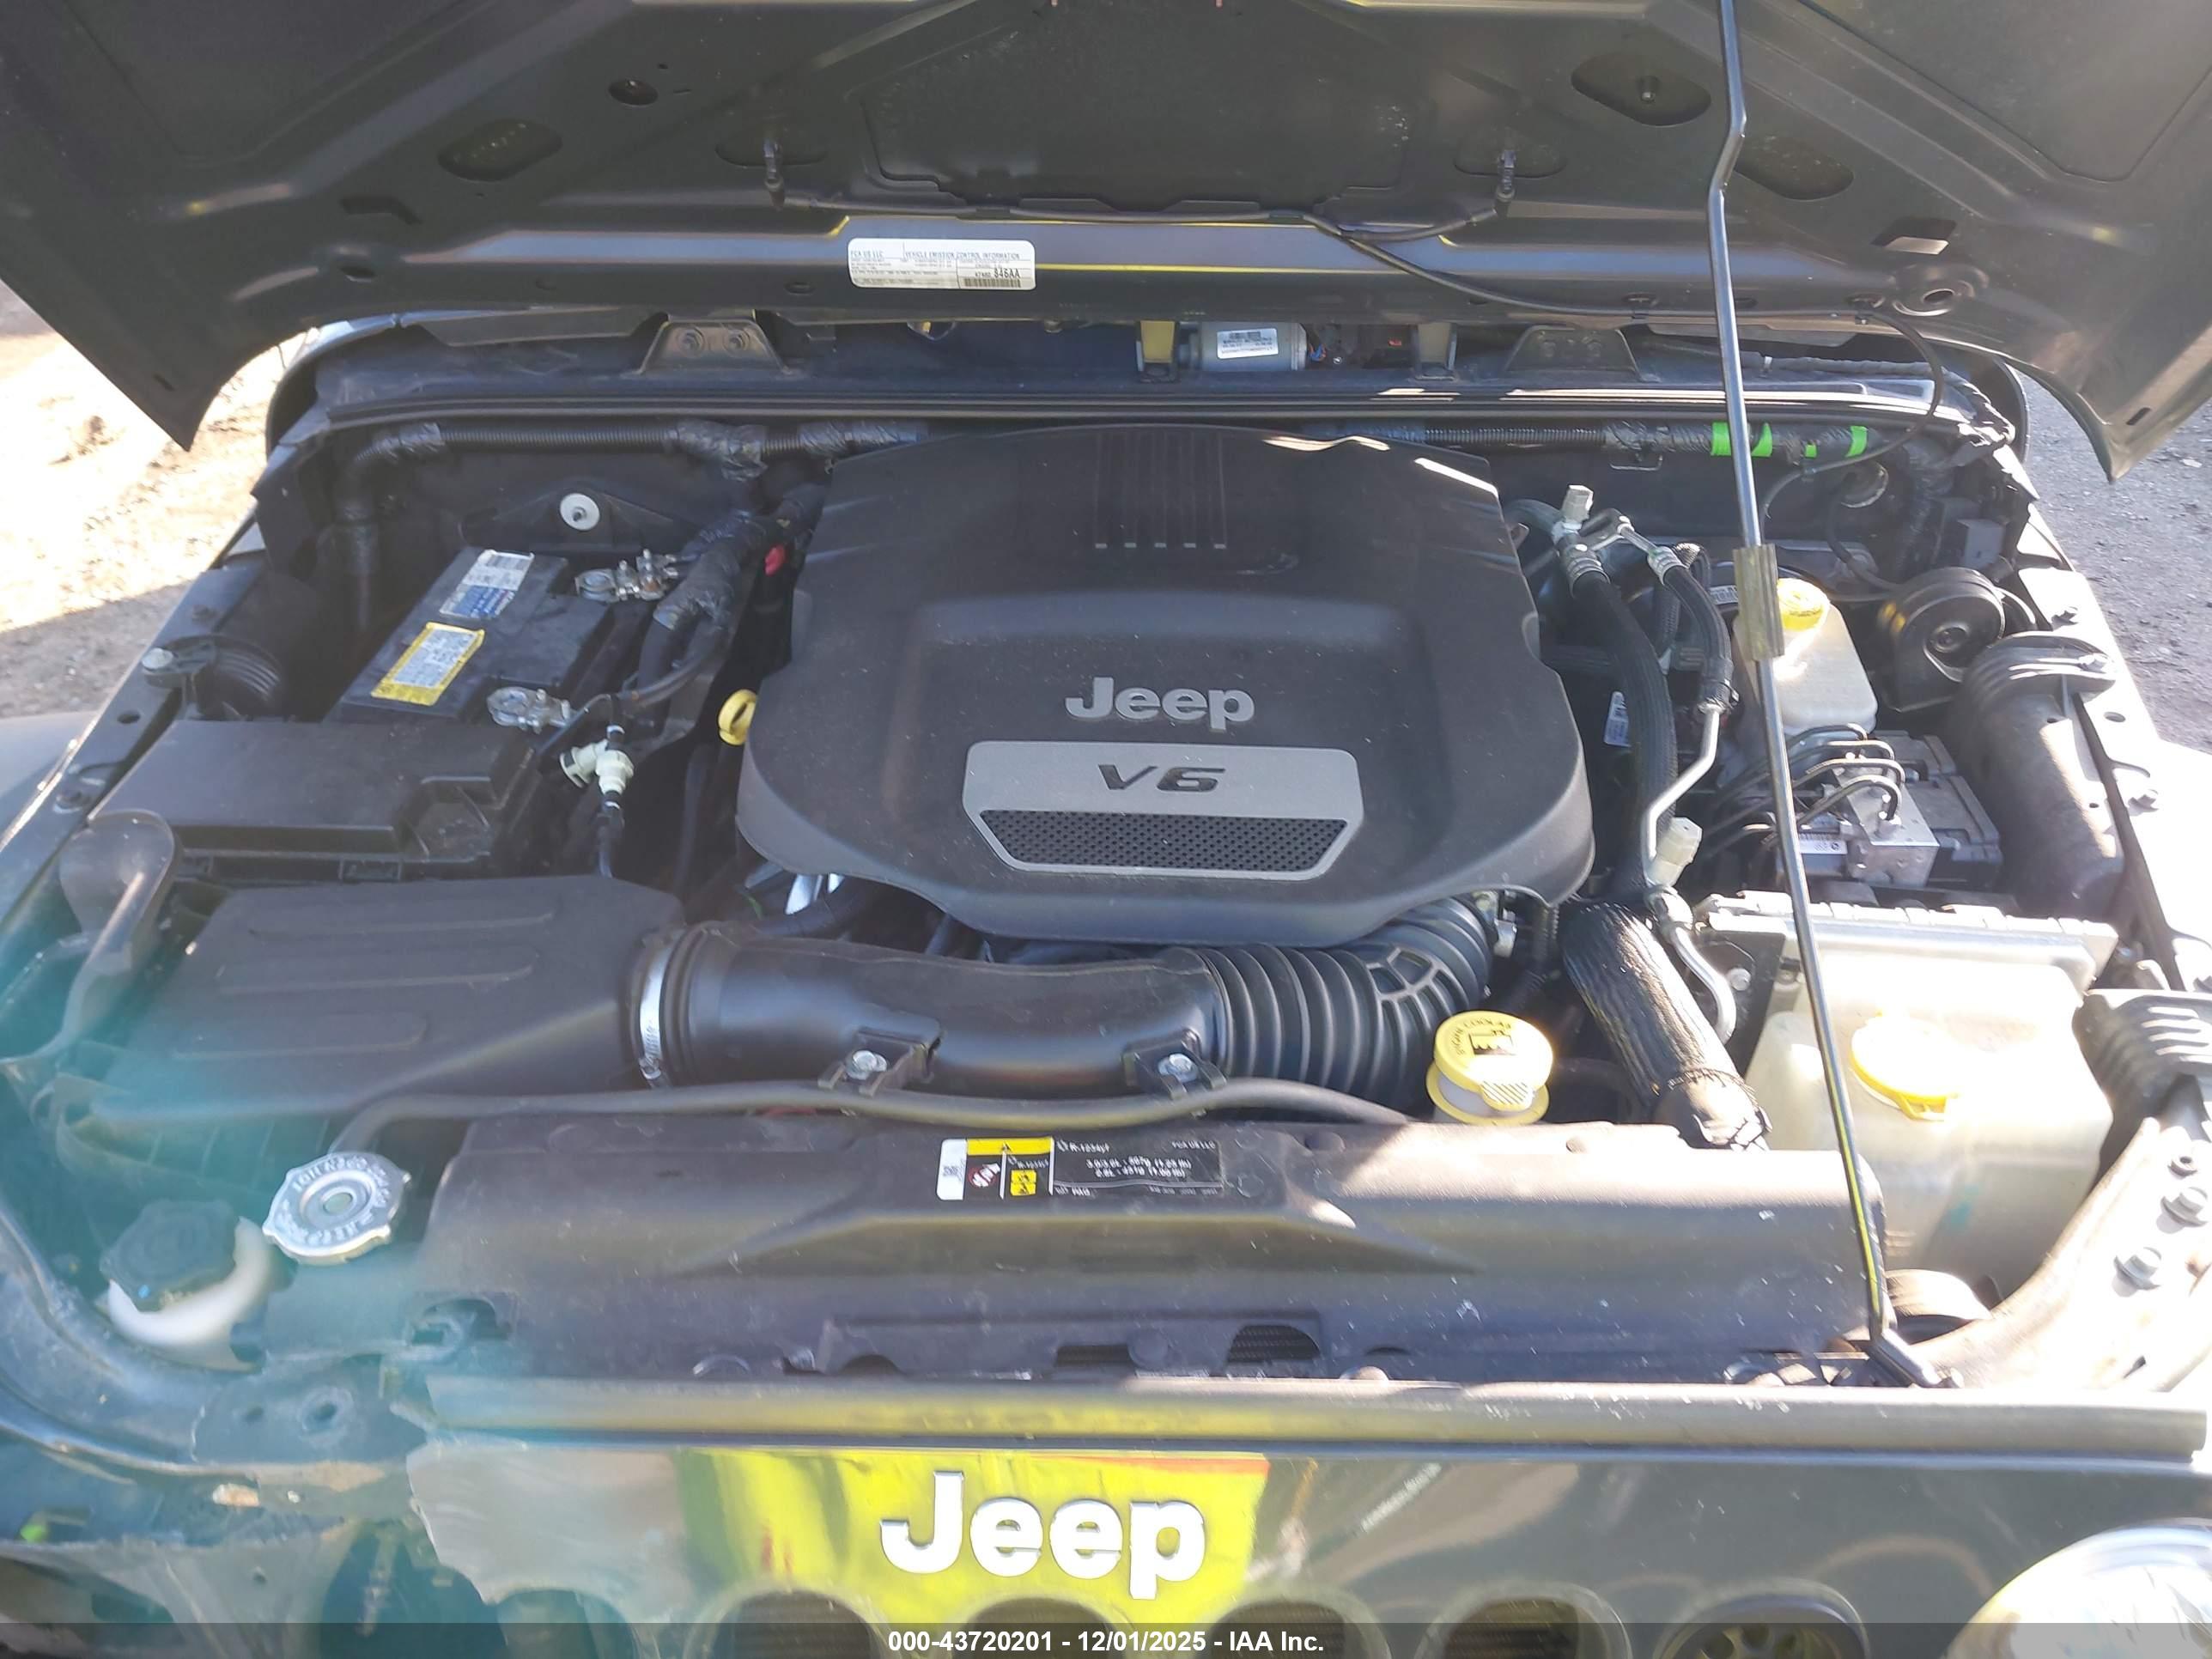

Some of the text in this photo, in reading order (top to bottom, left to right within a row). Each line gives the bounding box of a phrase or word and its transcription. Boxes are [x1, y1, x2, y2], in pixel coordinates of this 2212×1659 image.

[957, 252, 981, 260] CONTROL
[982, 252, 1020, 260] INFORMATION
[1065, 677, 1255, 731] Jeep
[1097, 764, 1226, 792] V6
[879, 1470, 1206, 1600] Jeep
